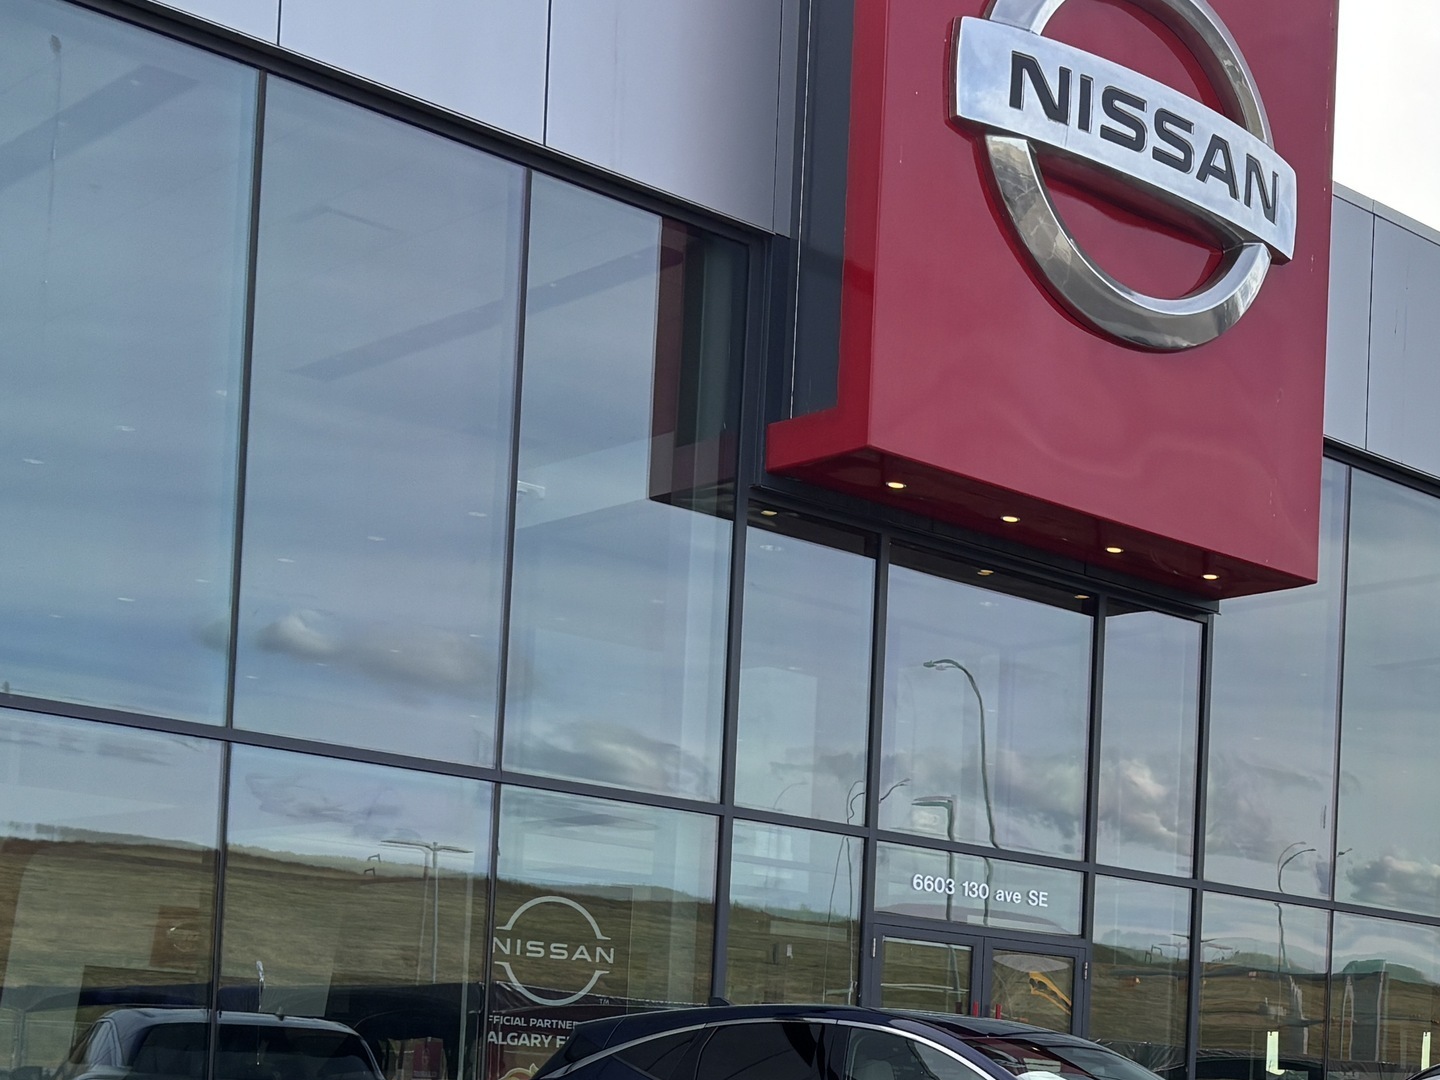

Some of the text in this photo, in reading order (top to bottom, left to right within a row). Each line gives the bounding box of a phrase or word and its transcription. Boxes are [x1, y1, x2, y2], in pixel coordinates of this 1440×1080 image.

[1009, 50, 1279, 226] NISSAN
[912, 873, 1049, 908] 6603 130 ave SE
[492, 936, 615, 964] NISSAN
[556, 1035, 570, 1049] F
